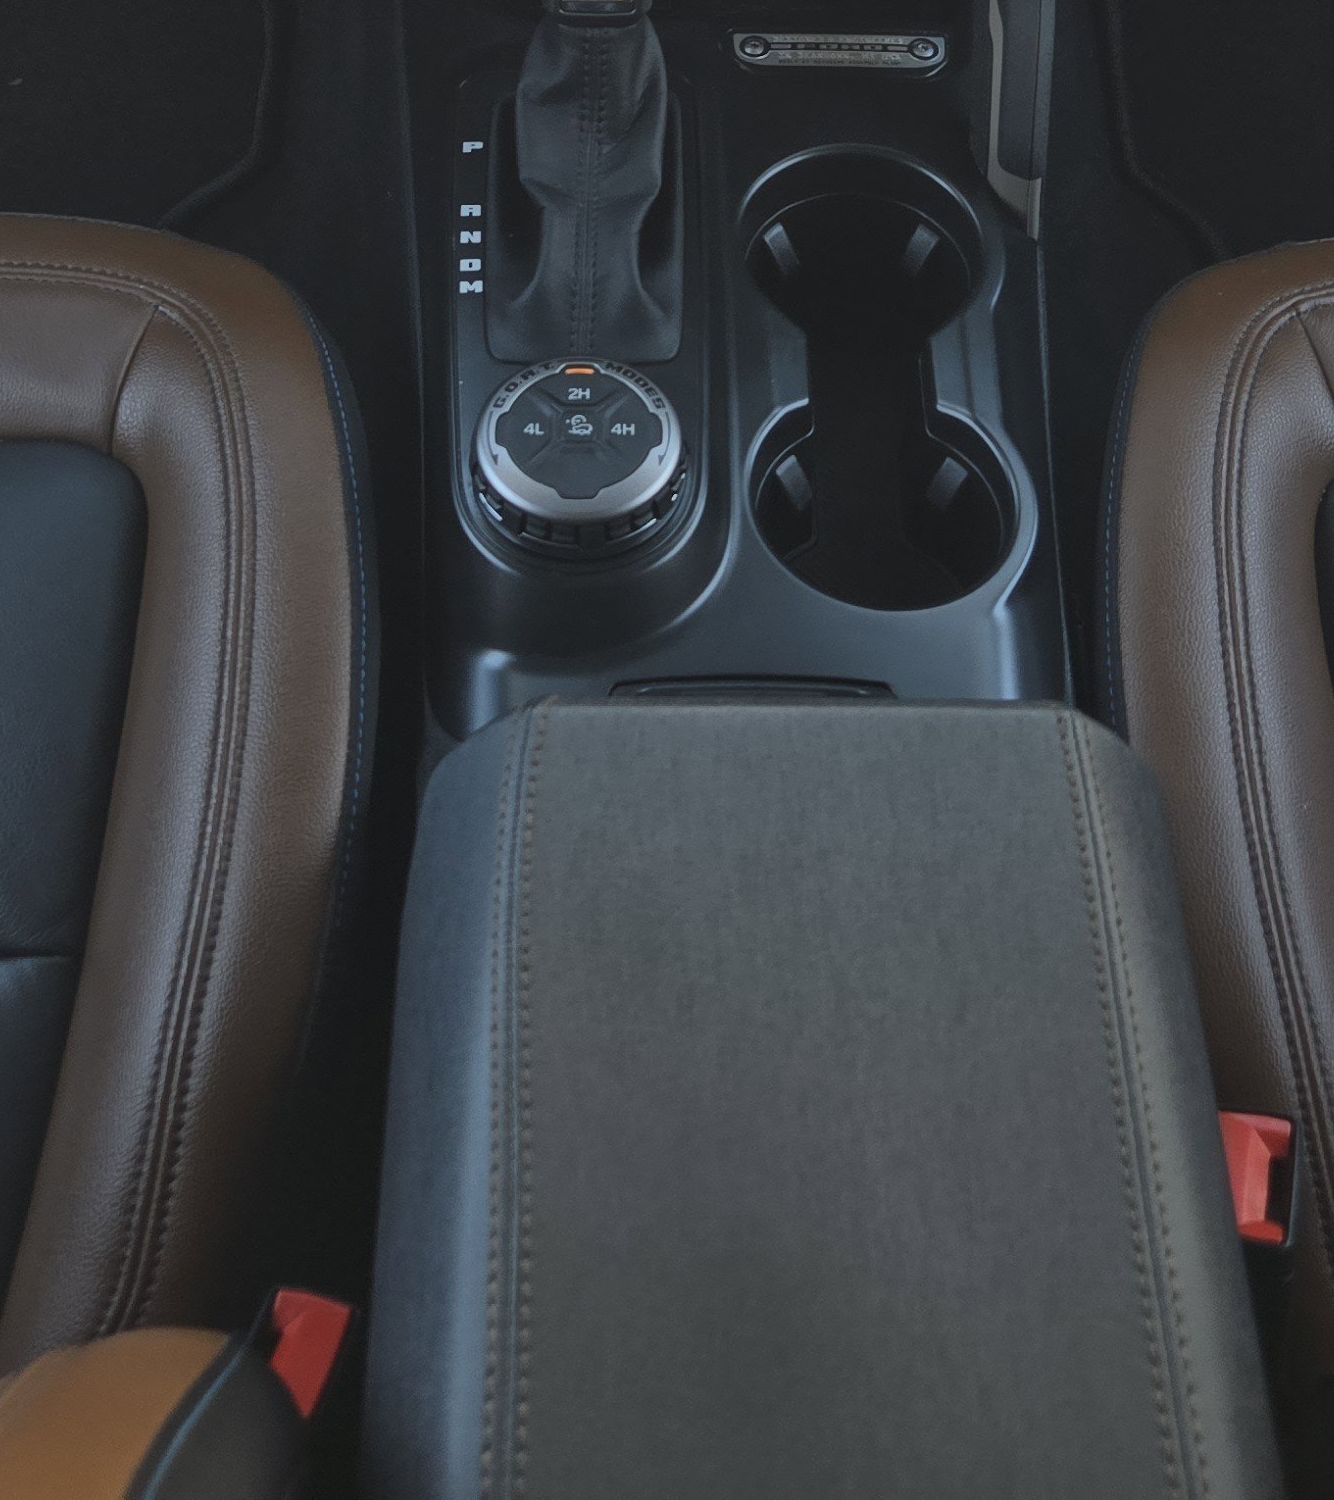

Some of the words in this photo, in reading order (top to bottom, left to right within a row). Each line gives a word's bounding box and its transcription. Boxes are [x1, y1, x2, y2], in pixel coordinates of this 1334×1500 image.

[462, 141, 484, 153] P
[460, 230, 482, 244] N
[459, 259, 482, 272] D
[459, 280, 484, 294] M
[605, 361, 666, 410] MODES
[568, 387, 591, 400] 2H
[523, 423, 545, 436] 4L
[610, 423, 636, 436] 4H
